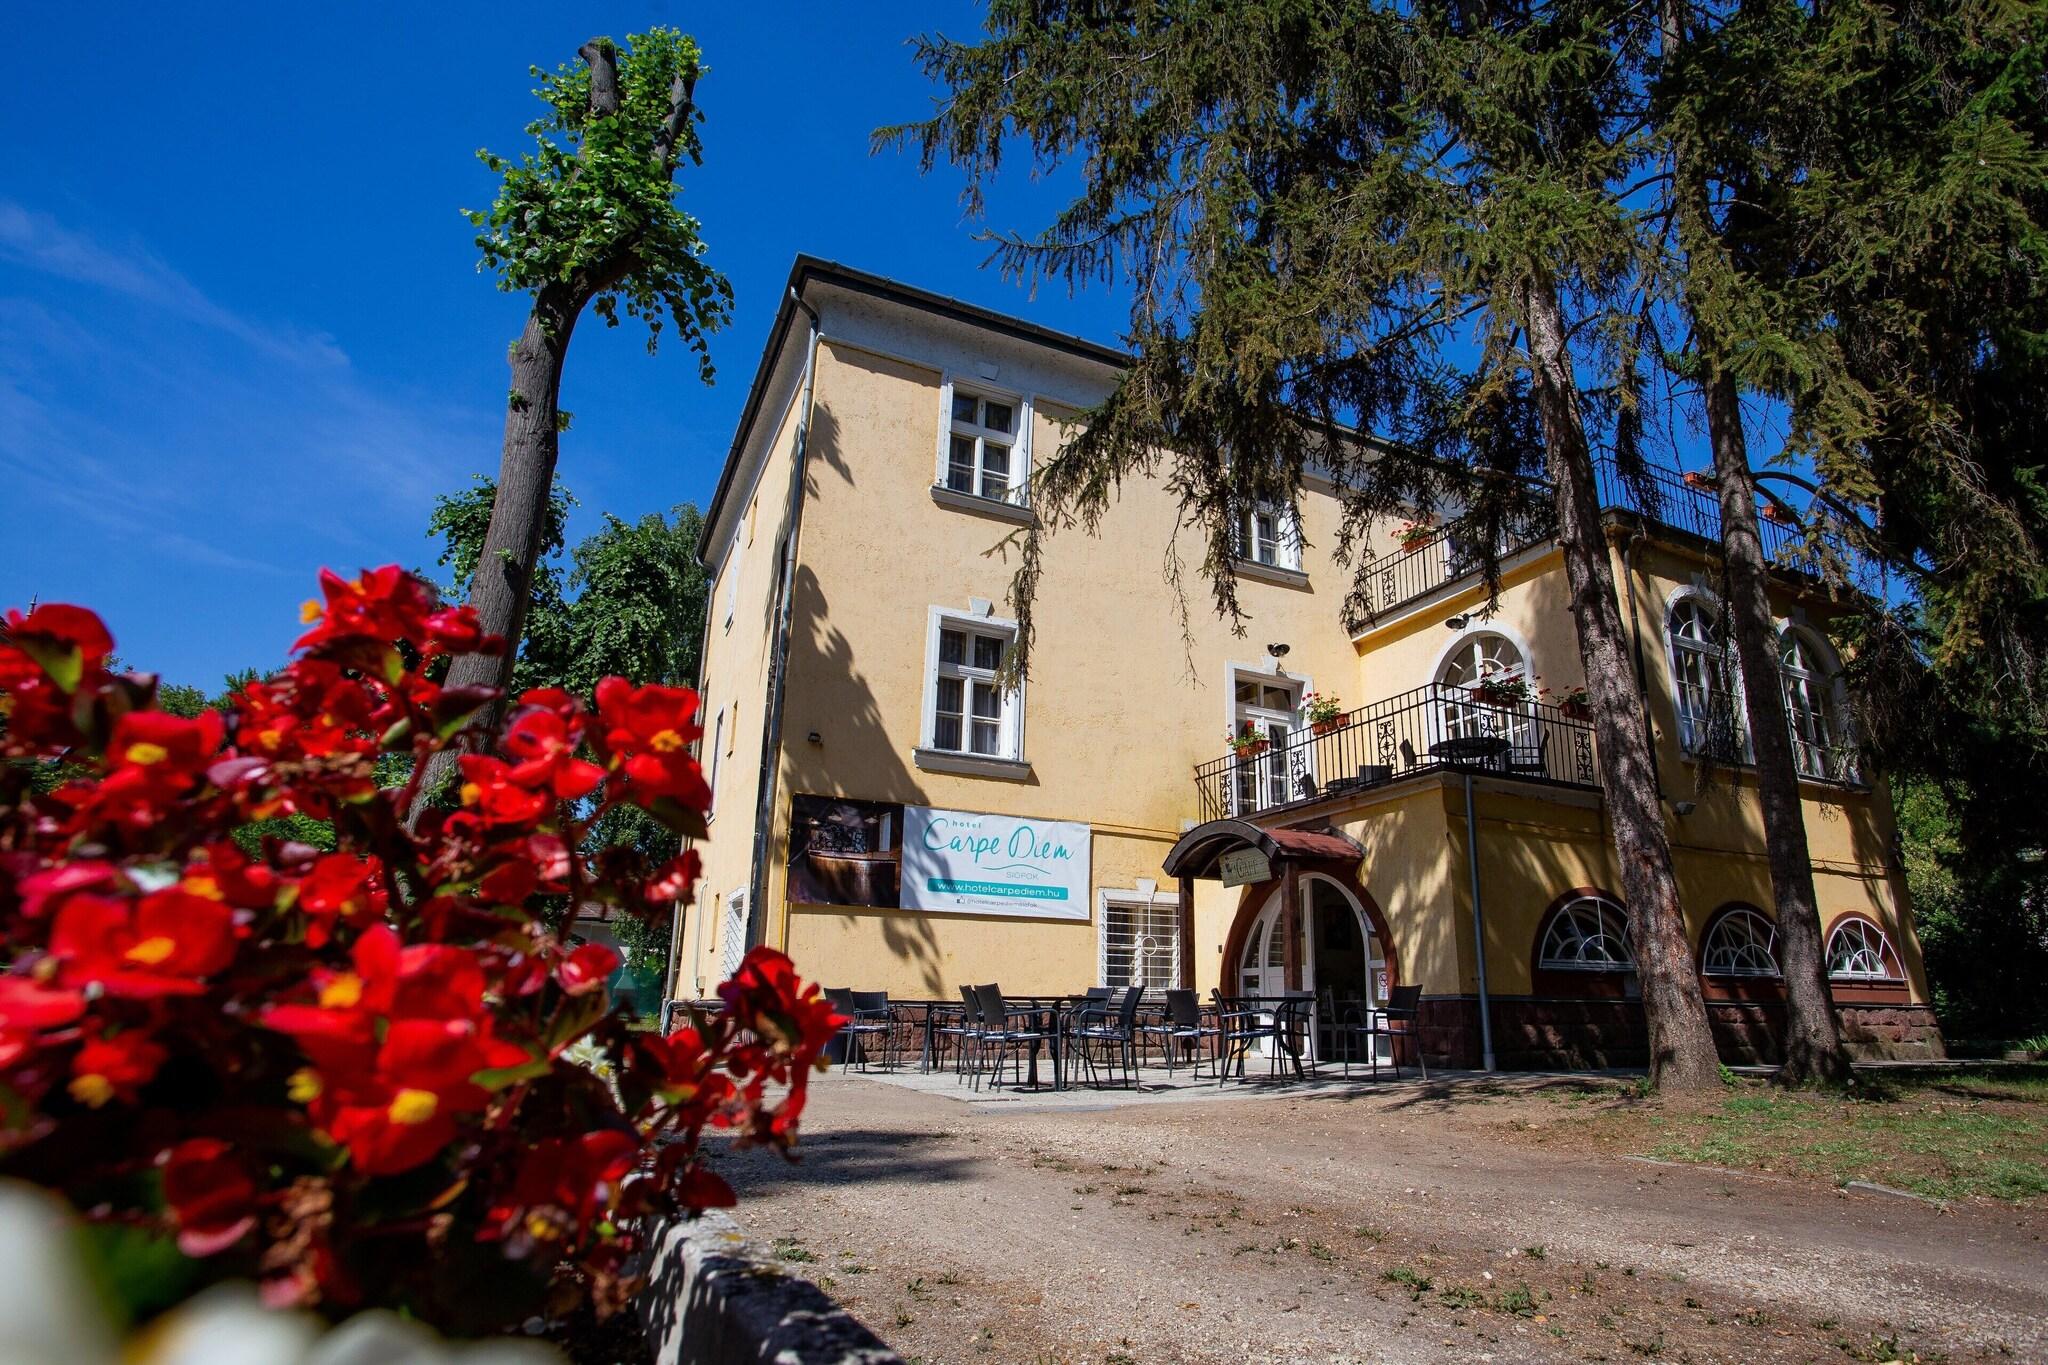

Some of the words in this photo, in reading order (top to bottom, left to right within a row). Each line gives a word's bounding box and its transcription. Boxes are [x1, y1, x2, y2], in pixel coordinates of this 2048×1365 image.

[952, 820, 982, 829] hotel
[923, 817, 1000, 863] Carpe
[1008, 825, 1074, 861] Diem
[937, 882, 1060, 898] www.hotelcarpediem.hu
